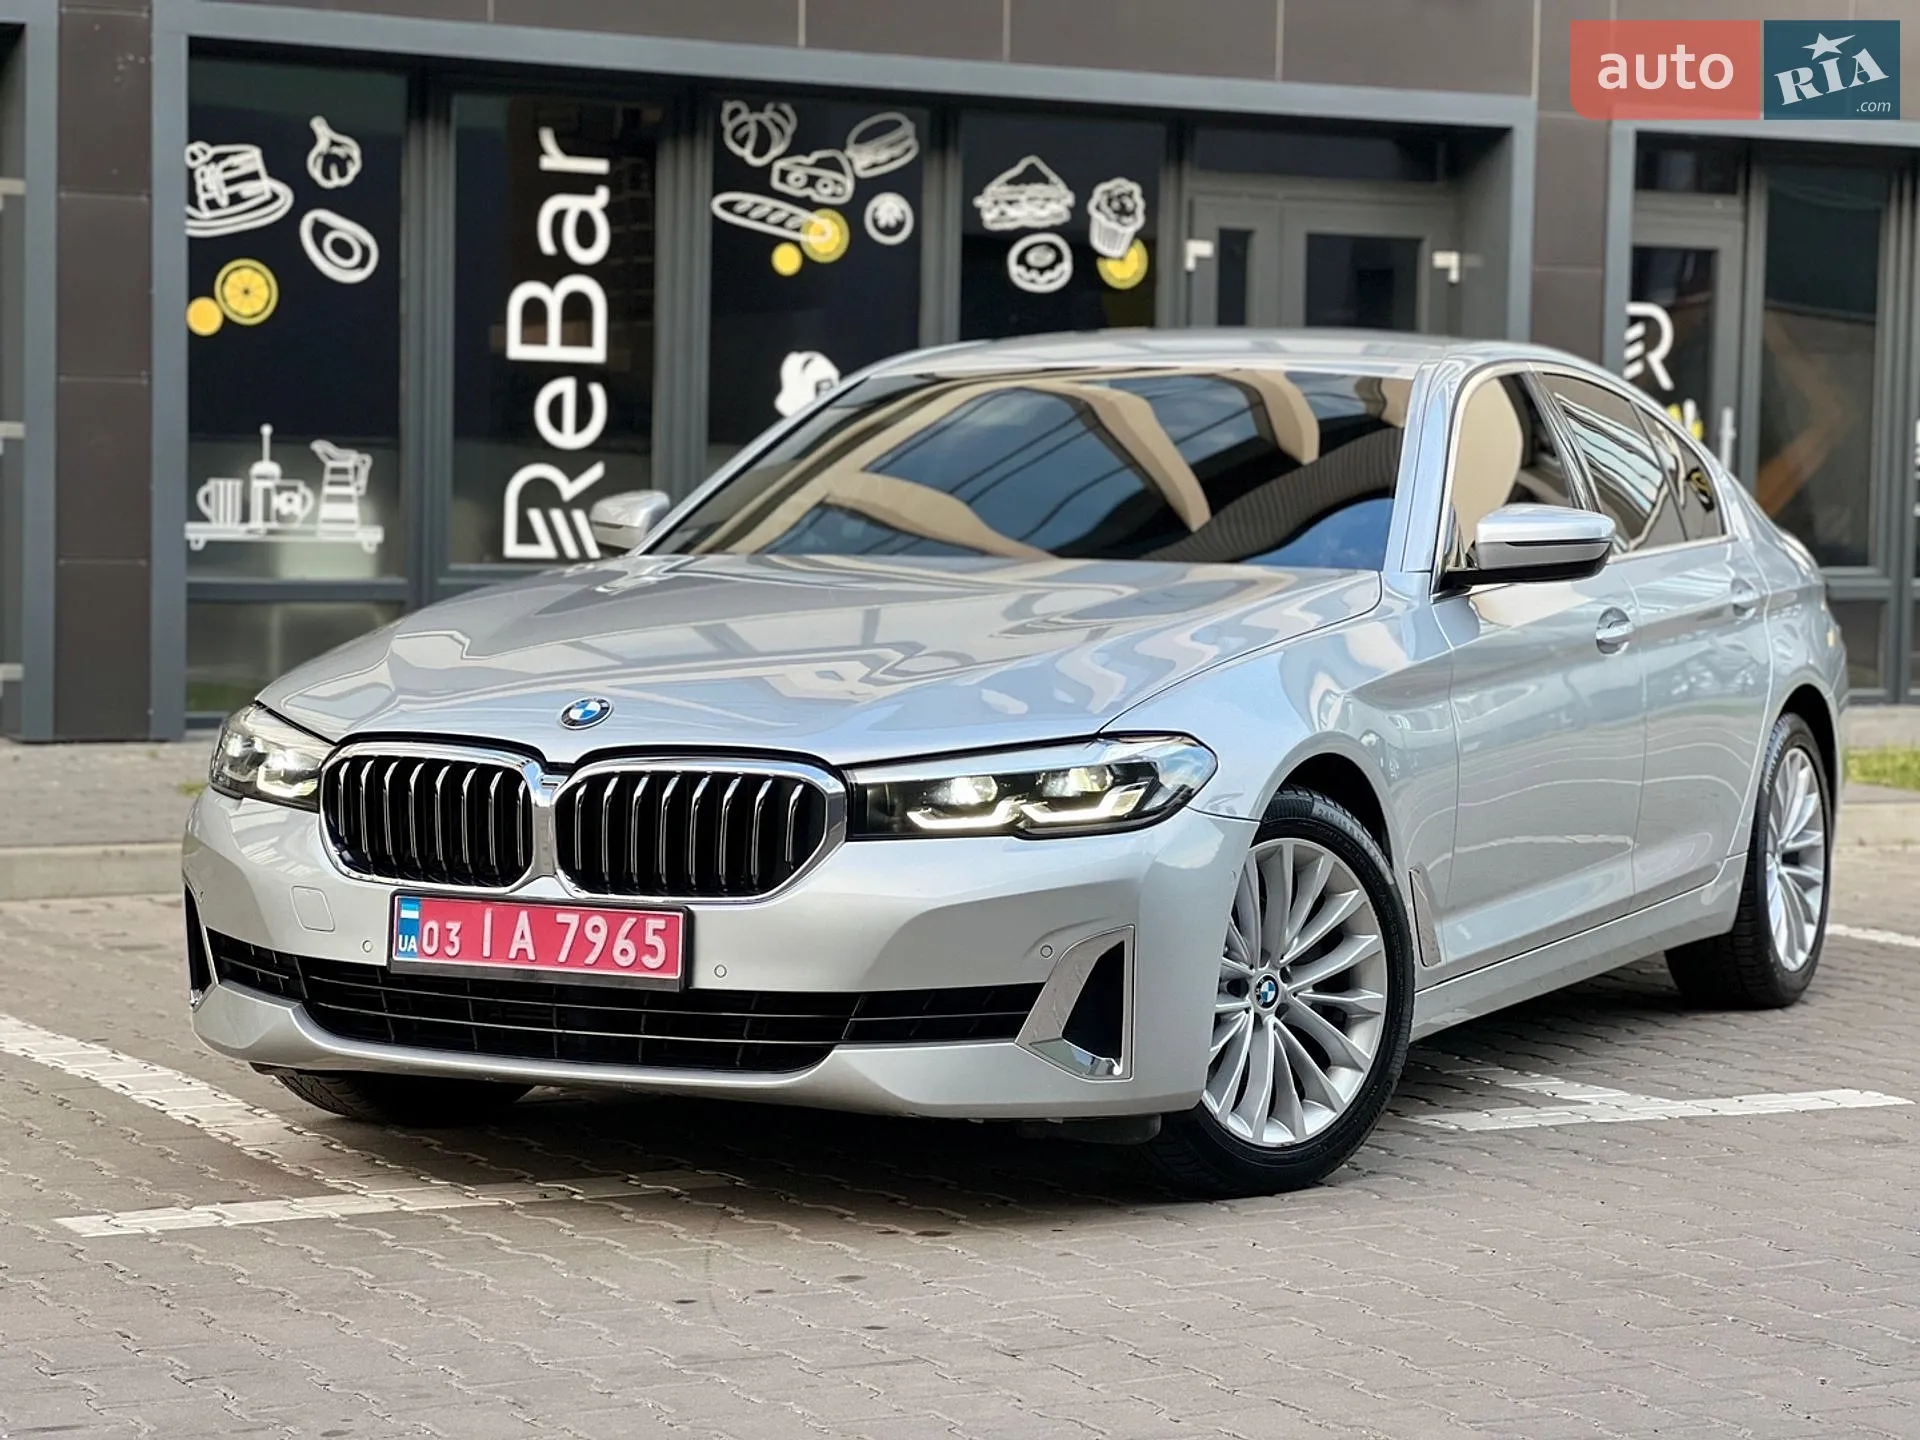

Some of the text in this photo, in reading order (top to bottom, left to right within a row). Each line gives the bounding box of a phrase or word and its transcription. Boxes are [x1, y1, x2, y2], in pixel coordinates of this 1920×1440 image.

[502, 126, 611, 559] ReBar
[399, 934, 418, 953] UA
[421, 919, 462, 957] 03
[555, 912, 667, 970] 7965
